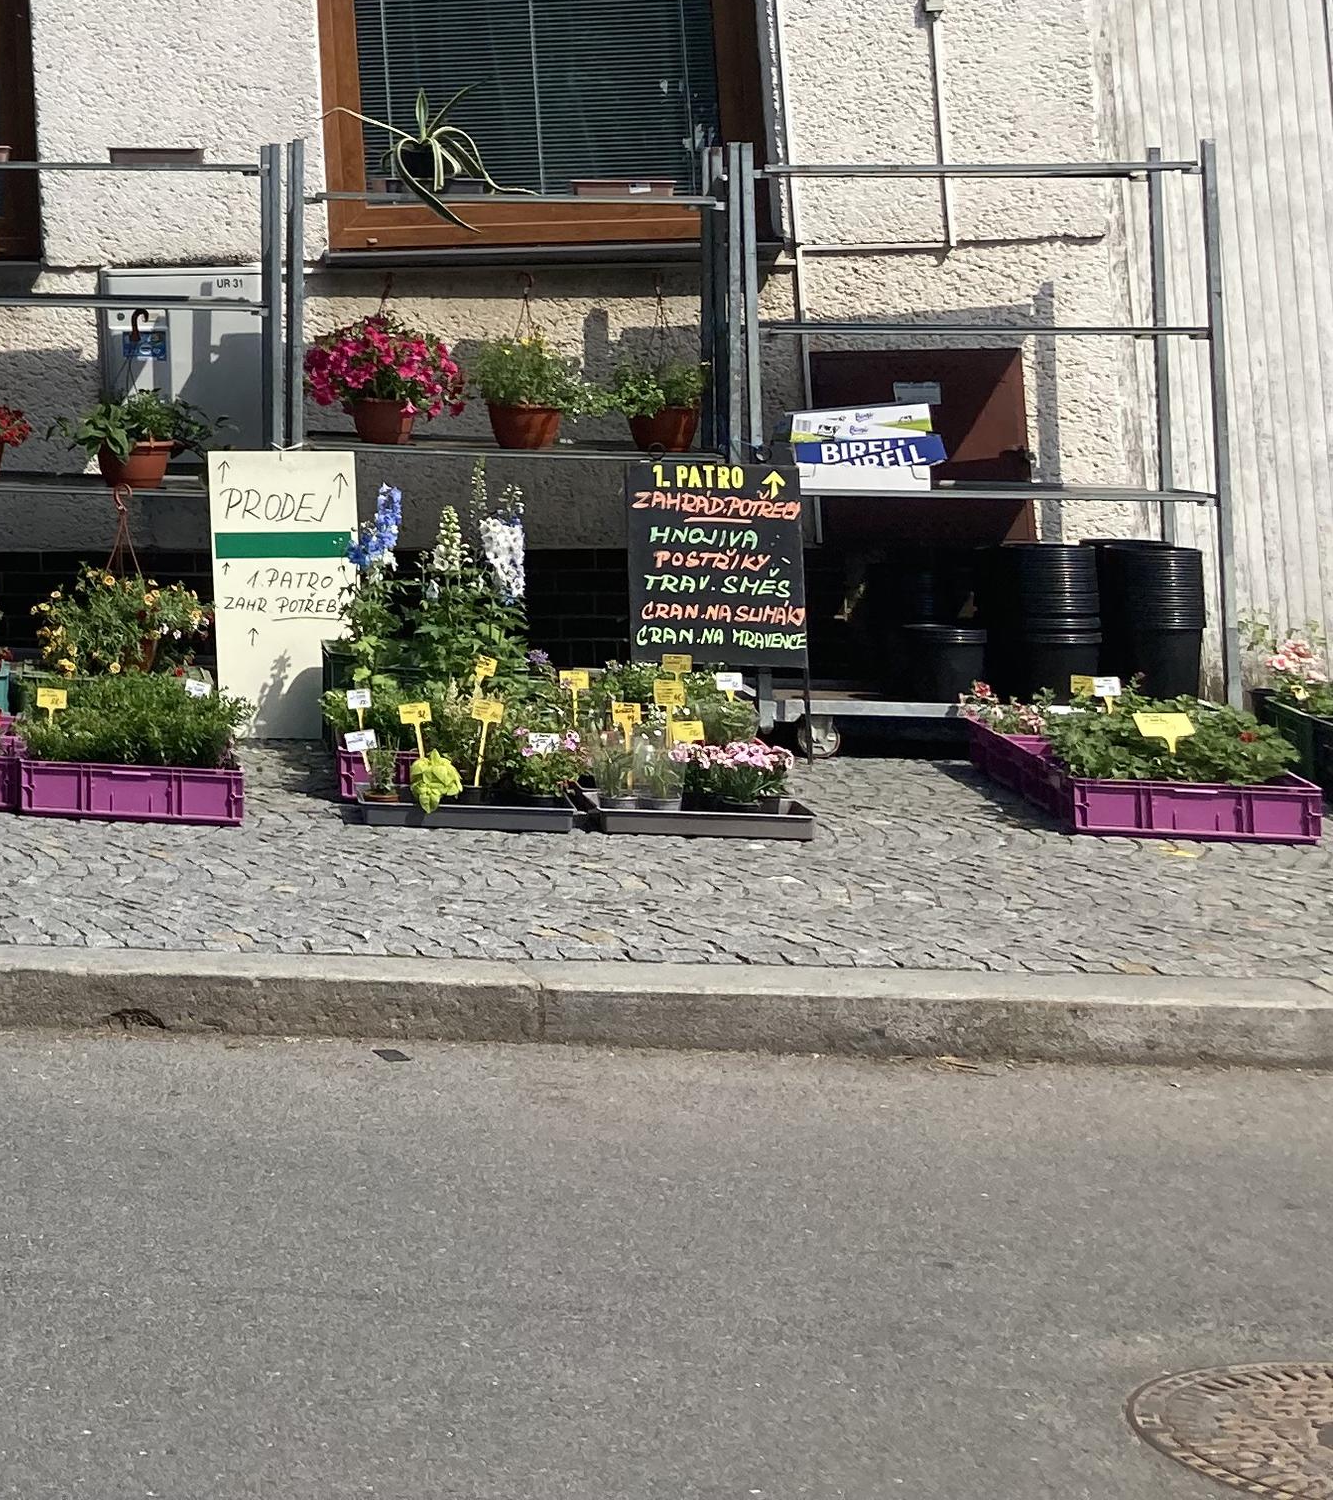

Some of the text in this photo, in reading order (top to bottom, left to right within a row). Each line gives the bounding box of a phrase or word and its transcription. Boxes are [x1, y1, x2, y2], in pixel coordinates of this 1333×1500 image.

[216, 278, 243, 288] UR 31
[653, 464, 744, 490] 1. PATRO
[220, 487, 332, 522] PRODEJ
[649, 526, 759, 550] HNOJIVA
[653, 549, 771, 572] POSTŘIKY
[265, 568, 333, 591] PATRO
[644, 568, 791, 598] TRAV. SMĚS
[732, 629, 807, 650] MRAVENCE
